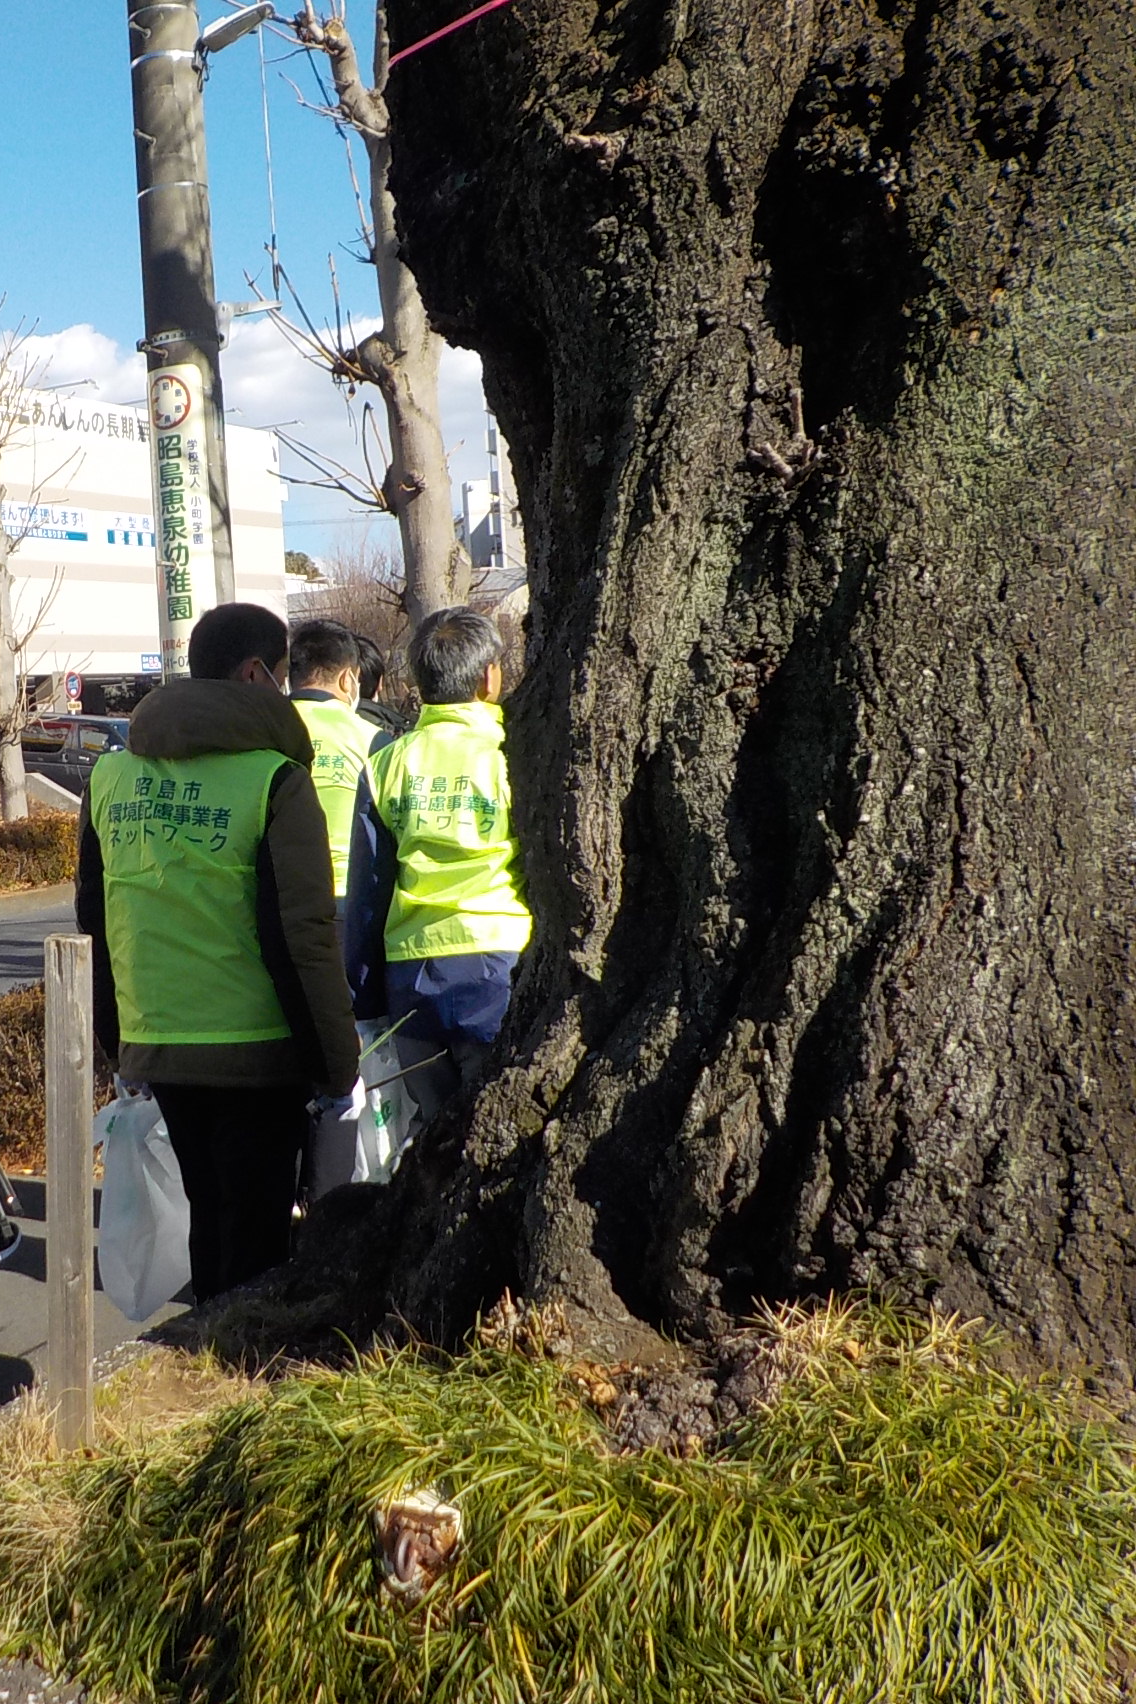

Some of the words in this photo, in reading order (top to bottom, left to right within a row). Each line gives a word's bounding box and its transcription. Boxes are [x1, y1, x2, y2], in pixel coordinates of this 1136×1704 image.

[157, 434, 192, 621] 昭島恵泉幼稚園
[312, 754, 345, 769] 業者
[135, 777, 202, 801] 昭島市
[408, 775, 470, 793] 昭島市
[108, 800, 231, 829] 環境配慮事業者
[110, 824, 228, 852] ネットワーク
